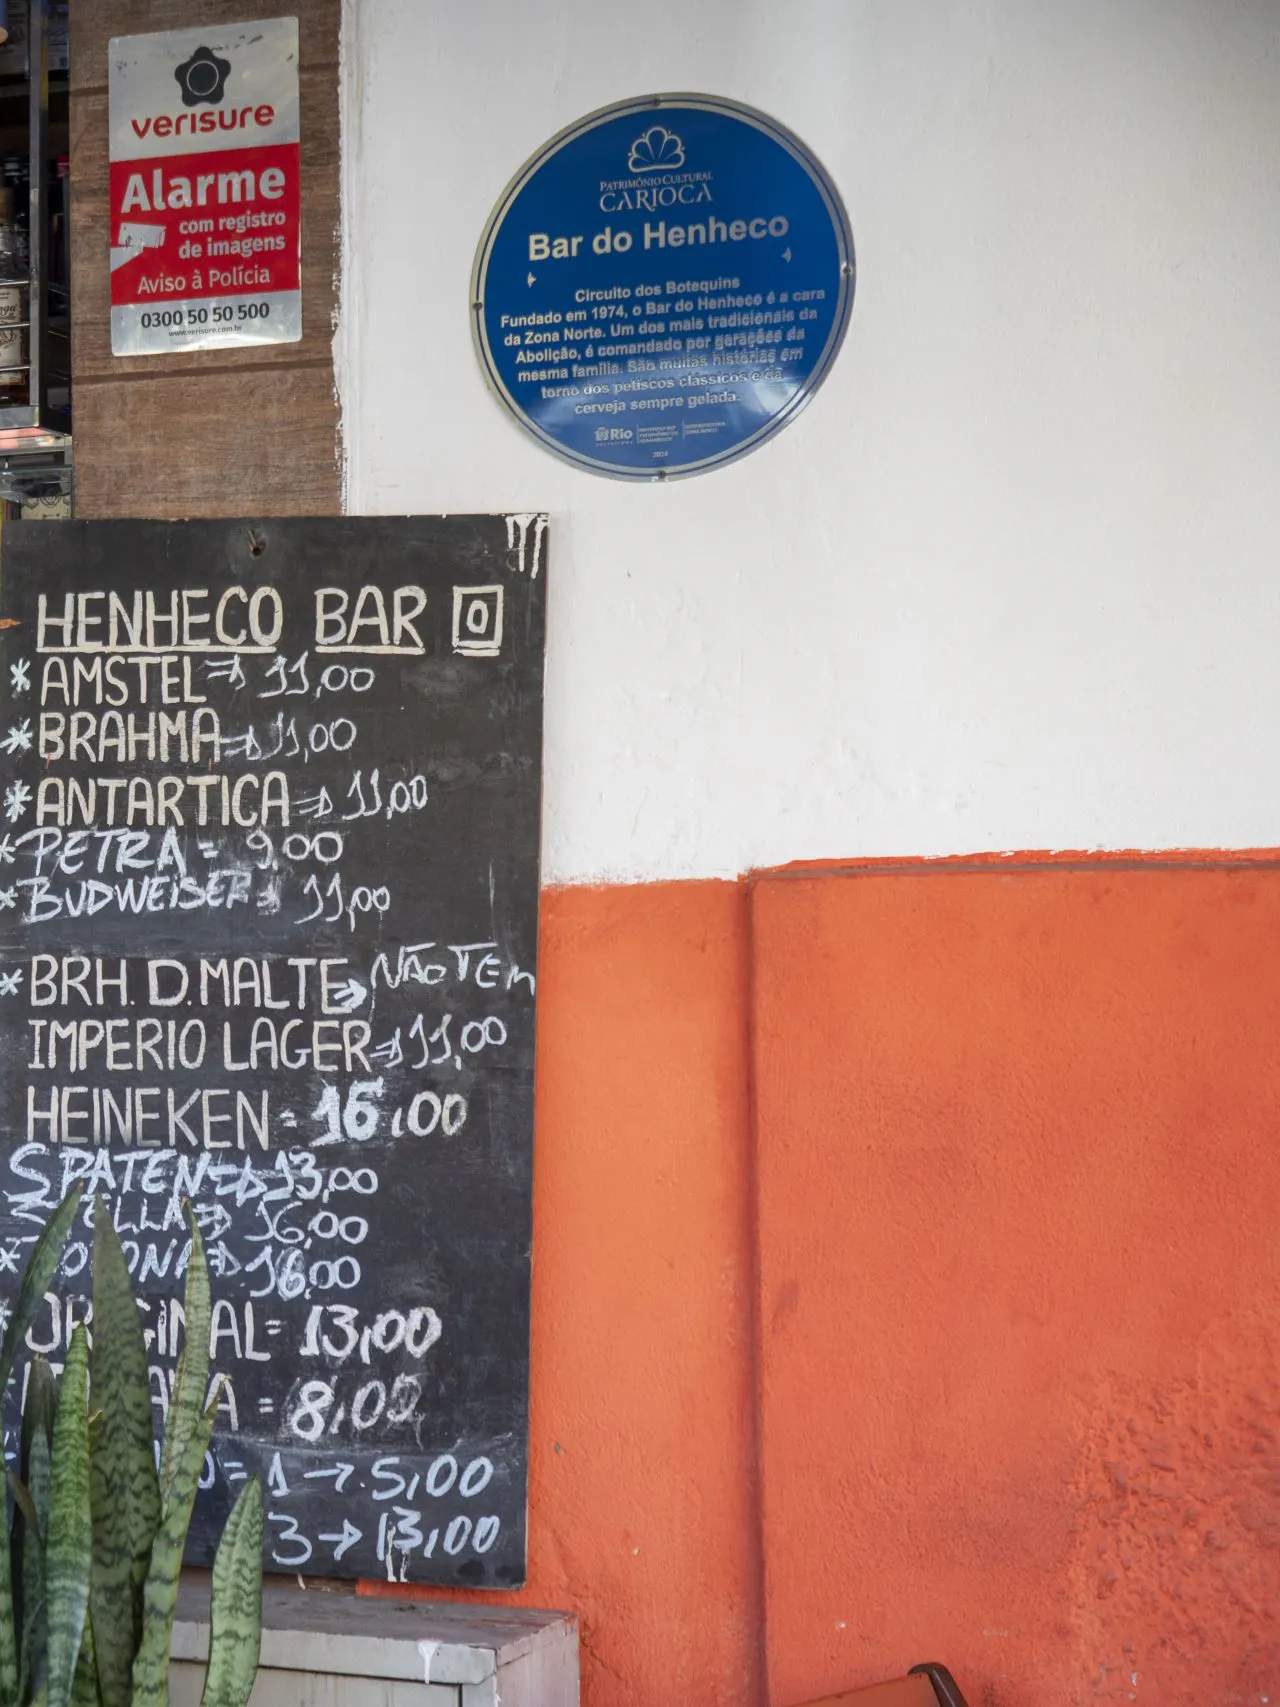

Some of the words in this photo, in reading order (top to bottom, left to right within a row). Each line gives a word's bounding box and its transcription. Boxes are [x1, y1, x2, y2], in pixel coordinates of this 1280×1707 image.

[131, 104, 275, 139] verisure
[121, 167, 286, 213] Alarme
[600, 182, 713, 212] CARIOCA
[179, 215, 214, 235] com
[218, 209, 286, 236] registro
[528, 232, 584, 262] Bar
[592, 227, 633, 256] do
[643, 214, 790, 251] Henheco
[178, 240, 203, 259] de
[207, 233, 286, 259] imagens
[138, 274, 186, 295] Aviso
[191, 269, 203, 289] à
[209, 264, 270, 287] Polícia
[575, 286, 631, 303] Circuito
[635, 284, 662, 297] dos
[665, 276, 741, 294] Botequins
[140, 310, 183, 329] 0300
[187, 308, 208, 324] 50
[212, 305, 233, 322] 50
[238, 302, 270, 320] 500
[500, 311, 562, 328] Fundado
[565, 310, 587, 322] em
[591, 304, 628, 320] 1974,
[632, 305, 642, 316] o
[646, 301, 672, 315] Bar
[675, 298, 694, 313] do
[697, 293, 762, 310] Henheco
[766, 291, 776, 305] é
[779, 292, 789, 303] a
[792, 288, 826, 302] cara
[504, 333, 521, 347] da
[524, 331, 560, 345] Zona
[564, 327, 606, 342] Norte.
[610, 324, 635, 337] Um
[638, 320, 666, 334] dos
[669, 317, 704, 332] mais
[708, 308, 795, 329] tradicionais
[799, 307, 818, 321] da
[515, 348, 582, 365] Abolição,
[585, 344, 594, 358] é
[597, 337, 682, 357] comandado
[686, 336, 711, 353] por
[714, 328, 782, 350] gerações
[786, 327, 805, 341] da
[518, 367, 569, 383] mesma
[627, 359, 656, 373] São
[659, 355, 708, 371] muitas
[712, 348, 777, 367] histórias
[780, 347, 803, 361] em
[541, 386, 579, 400] torno
[583, 383, 610, 396] dos
[614, 378, 675, 398] petiscos
[679, 370, 748, 389] clássicos
[751, 370, 761, 382] e
[574, 400, 626, 415] cerveja
[630, 395, 683, 412] sempre
[688, 391, 741, 409] gelada.
[610, 427, 634, 440] Rio
[36, 585, 283, 648] HENHECO
[314, 585, 428, 648] BAR
[39, 655, 207, 706] AMSTEL
[257, 651, 375, 699] 11,00
[38, 709, 221, 762] BRAHMA
[262, 711, 357, 762] 11,00
[36, 771, 291, 827] ANTARTICA
[341, 768, 428, 821] 11,00
[17, 826, 187, 876] PETRA
[246, 829, 344, 872] 9,00
[30, 953, 135, 1008] BRH.
[27, 1018, 207, 1071] IMPERIO
[222, 1018, 372, 1073] LAGER
[409, 1013, 508, 1071] 11,00
[26, 1085, 270, 1150] HEINEKEN
[3, 1142, 213, 1206] SPATEN
[262, 1150, 379, 1203] 13,00
[298, 1303, 443, 1364] 13,00
[372, 1454, 494, 1501] 5,00
[268, 1511, 312, 1566] 3
[376, 1504, 501, 1562] 13,00
